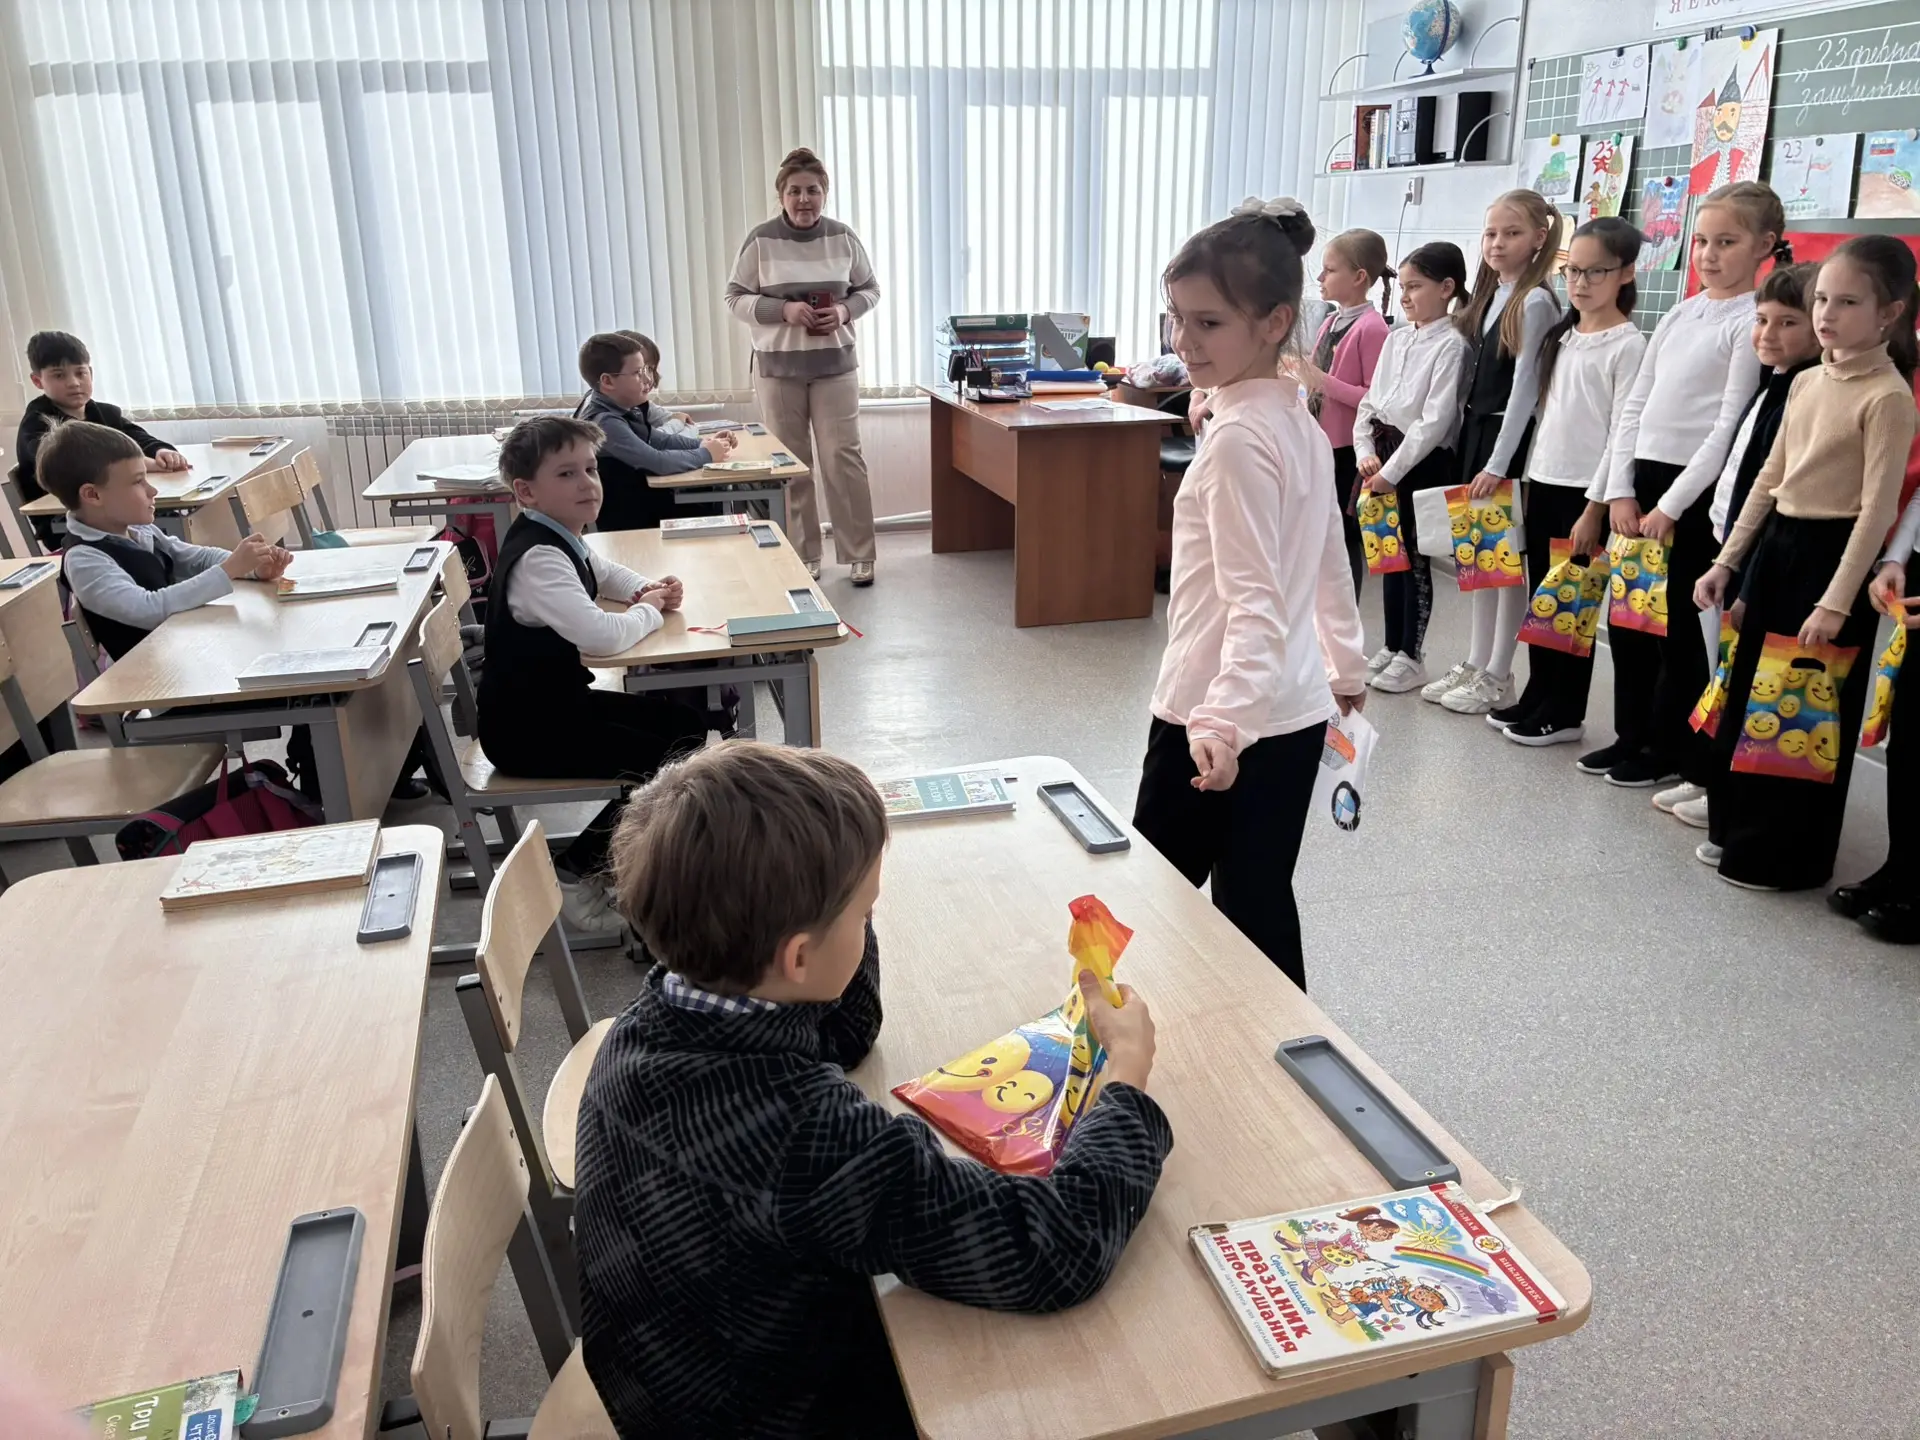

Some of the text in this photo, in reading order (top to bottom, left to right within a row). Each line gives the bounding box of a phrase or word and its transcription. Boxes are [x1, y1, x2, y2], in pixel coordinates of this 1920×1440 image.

[1782, 139, 1803, 159] 23
[1213, 1235, 1298, 1353] НЕПОСЛУШАНИЯ
[1237, 1239, 1312, 1339] ПРАЗДНИК
[1270, 1254, 1316, 1315] Сергей Михалков
[1498, 1257, 1545, 1306] БИБЛИОТЕКА
[129, 1395, 159, 1432] Три
